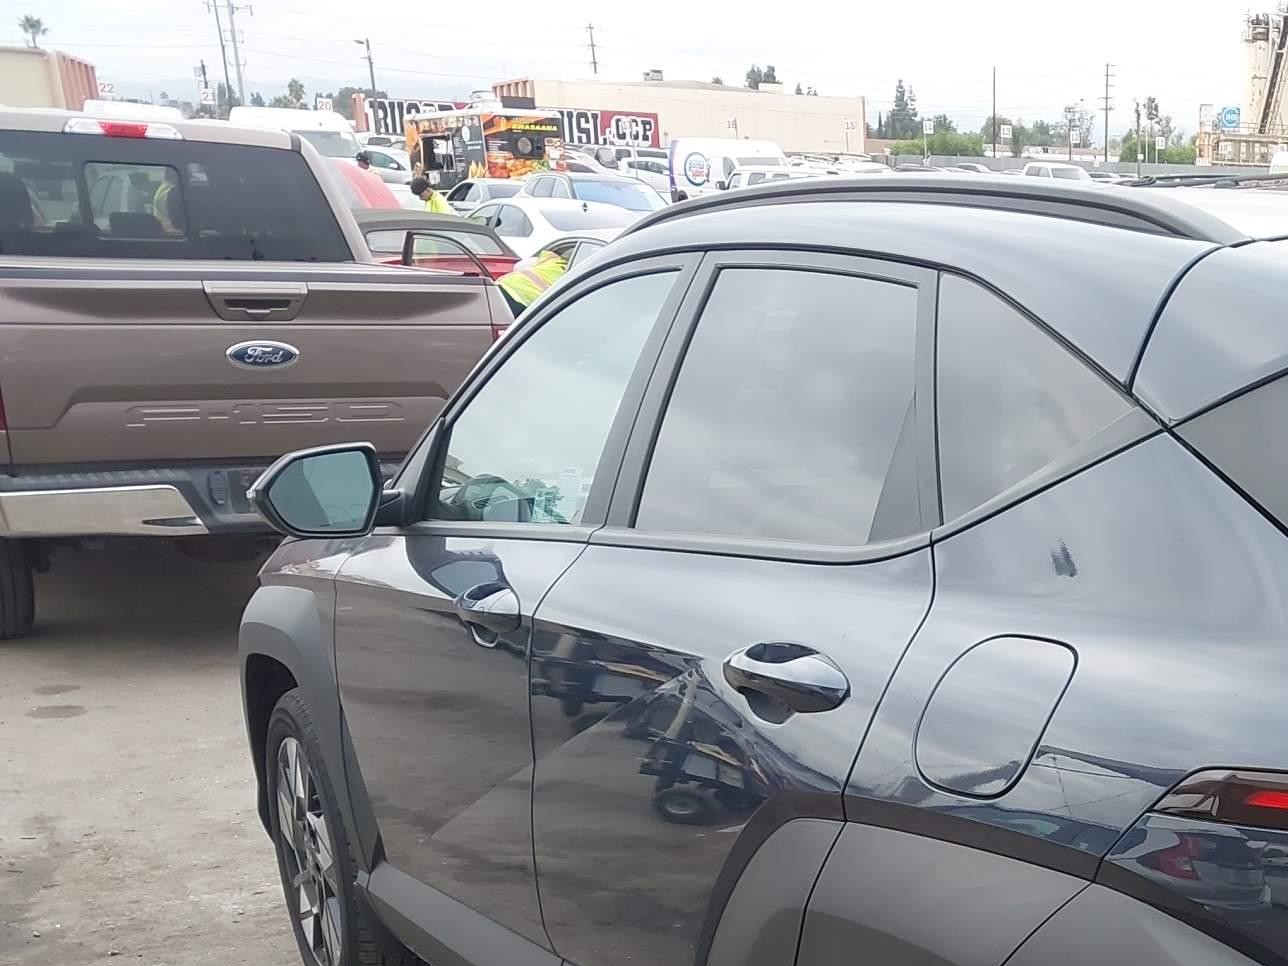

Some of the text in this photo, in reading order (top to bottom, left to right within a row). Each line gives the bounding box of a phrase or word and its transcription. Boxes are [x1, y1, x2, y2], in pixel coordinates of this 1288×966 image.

[99, 83, 115, 94] 22
[318, 101, 331, 111] 20
[245, 346, 284, 363] Ford
[125, 402, 405, 428] F-150
